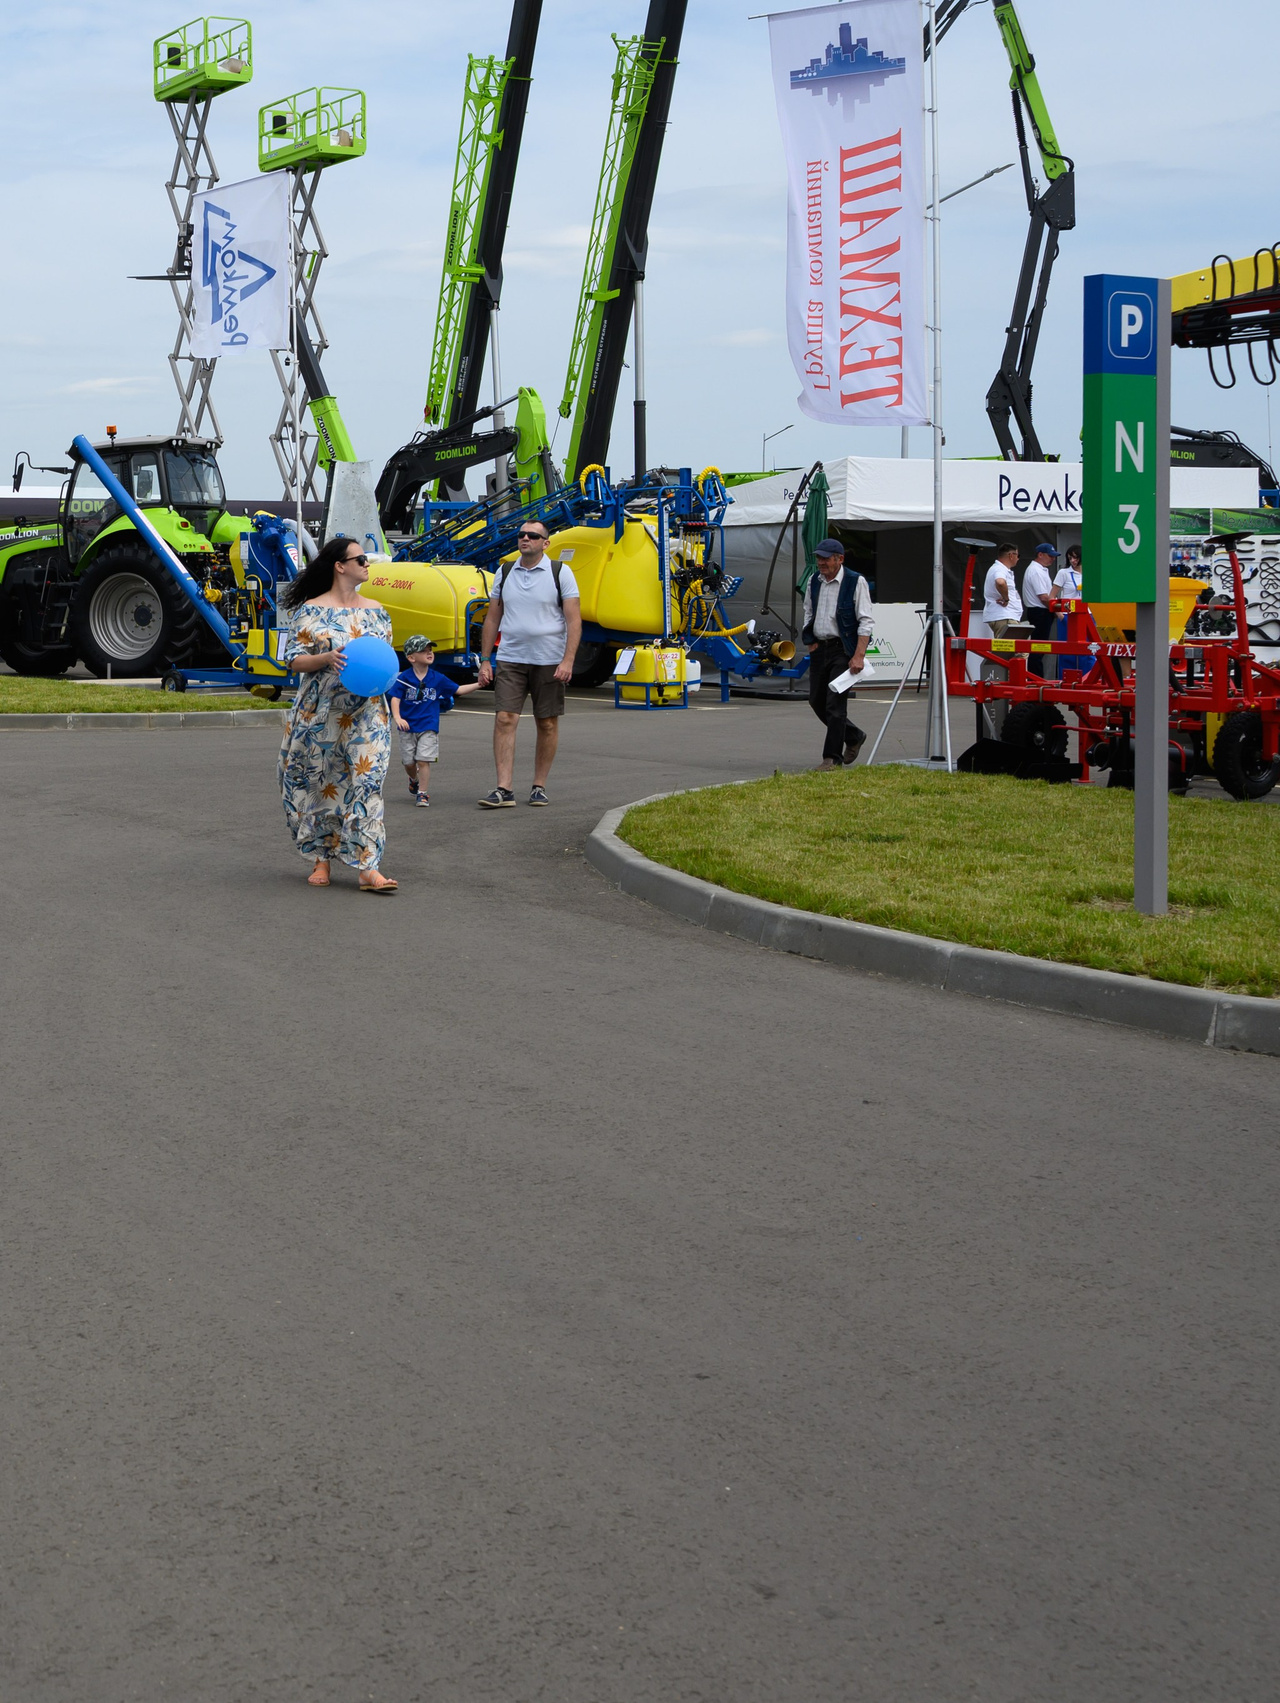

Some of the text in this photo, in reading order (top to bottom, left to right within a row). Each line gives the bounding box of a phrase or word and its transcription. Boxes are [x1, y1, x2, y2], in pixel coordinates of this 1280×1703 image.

[447, 210, 459, 266] ZOOMLION
[1120, 304, 1144, 348] P
[317, 416, 337, 460] ZOOMLION
[435, 445, 477, 461] ZOOMLION
[1115, 420, 1144, 473] N
[1170, 450, 1195, 460] MLION
[999, 473, 1083, 512] Ремк
[1117, 504, 1141, 554] 3
